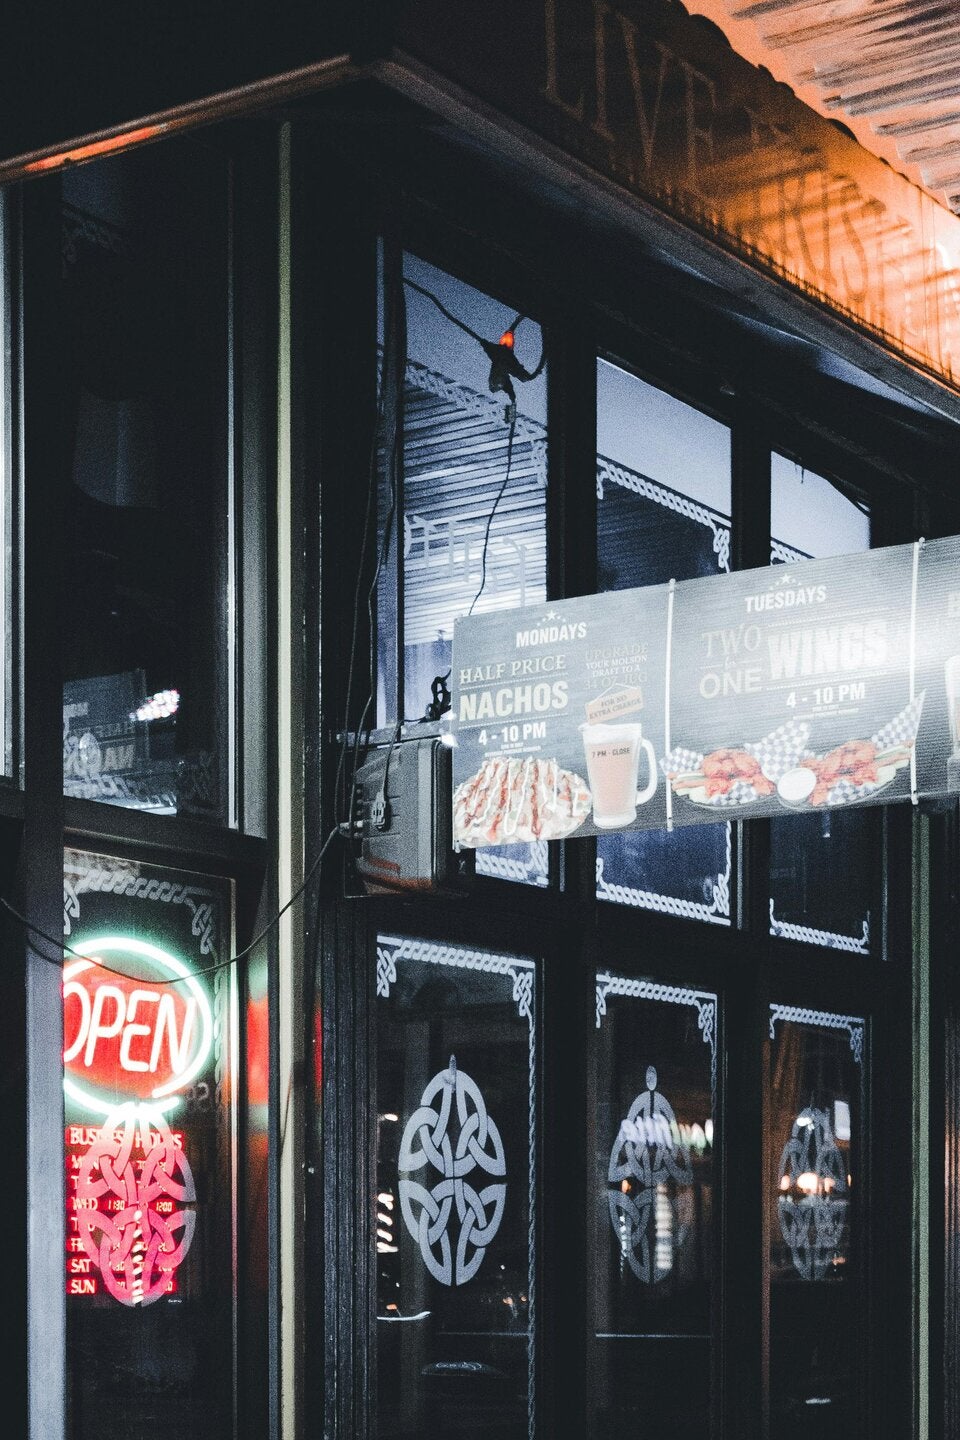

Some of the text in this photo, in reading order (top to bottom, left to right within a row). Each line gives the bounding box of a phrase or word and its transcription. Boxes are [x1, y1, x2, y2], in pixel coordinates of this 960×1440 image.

[744, 586, 826, 613] TUESDAYS
[516, 622, 587, 648] MONDAYS
[700, 623, 762, 658] TWO
[585, 643, 649, 661] UPGRADE
[767, 621, 888, 679] WINGS
[459, 655, 566, 685] HALF PRICE
[699, 669, 762, 699] ONE
[786, 692, 796, 709] 4
[813, 687, 833, 706] 10
[838, 683, 866, 702] PM
[459, 680, 568, 722] NACHOS
[478, 729, 488, 746] 4
[501, 725, 519, 742] 10
[523, 721, 547, 740] PM
[63, 981, 196, 1075] OPEN
[71, 1155, 100, 1169] MN
[71, 1259, 92, 1273] SAT
[71, 1280, 96, 1294] SUN
